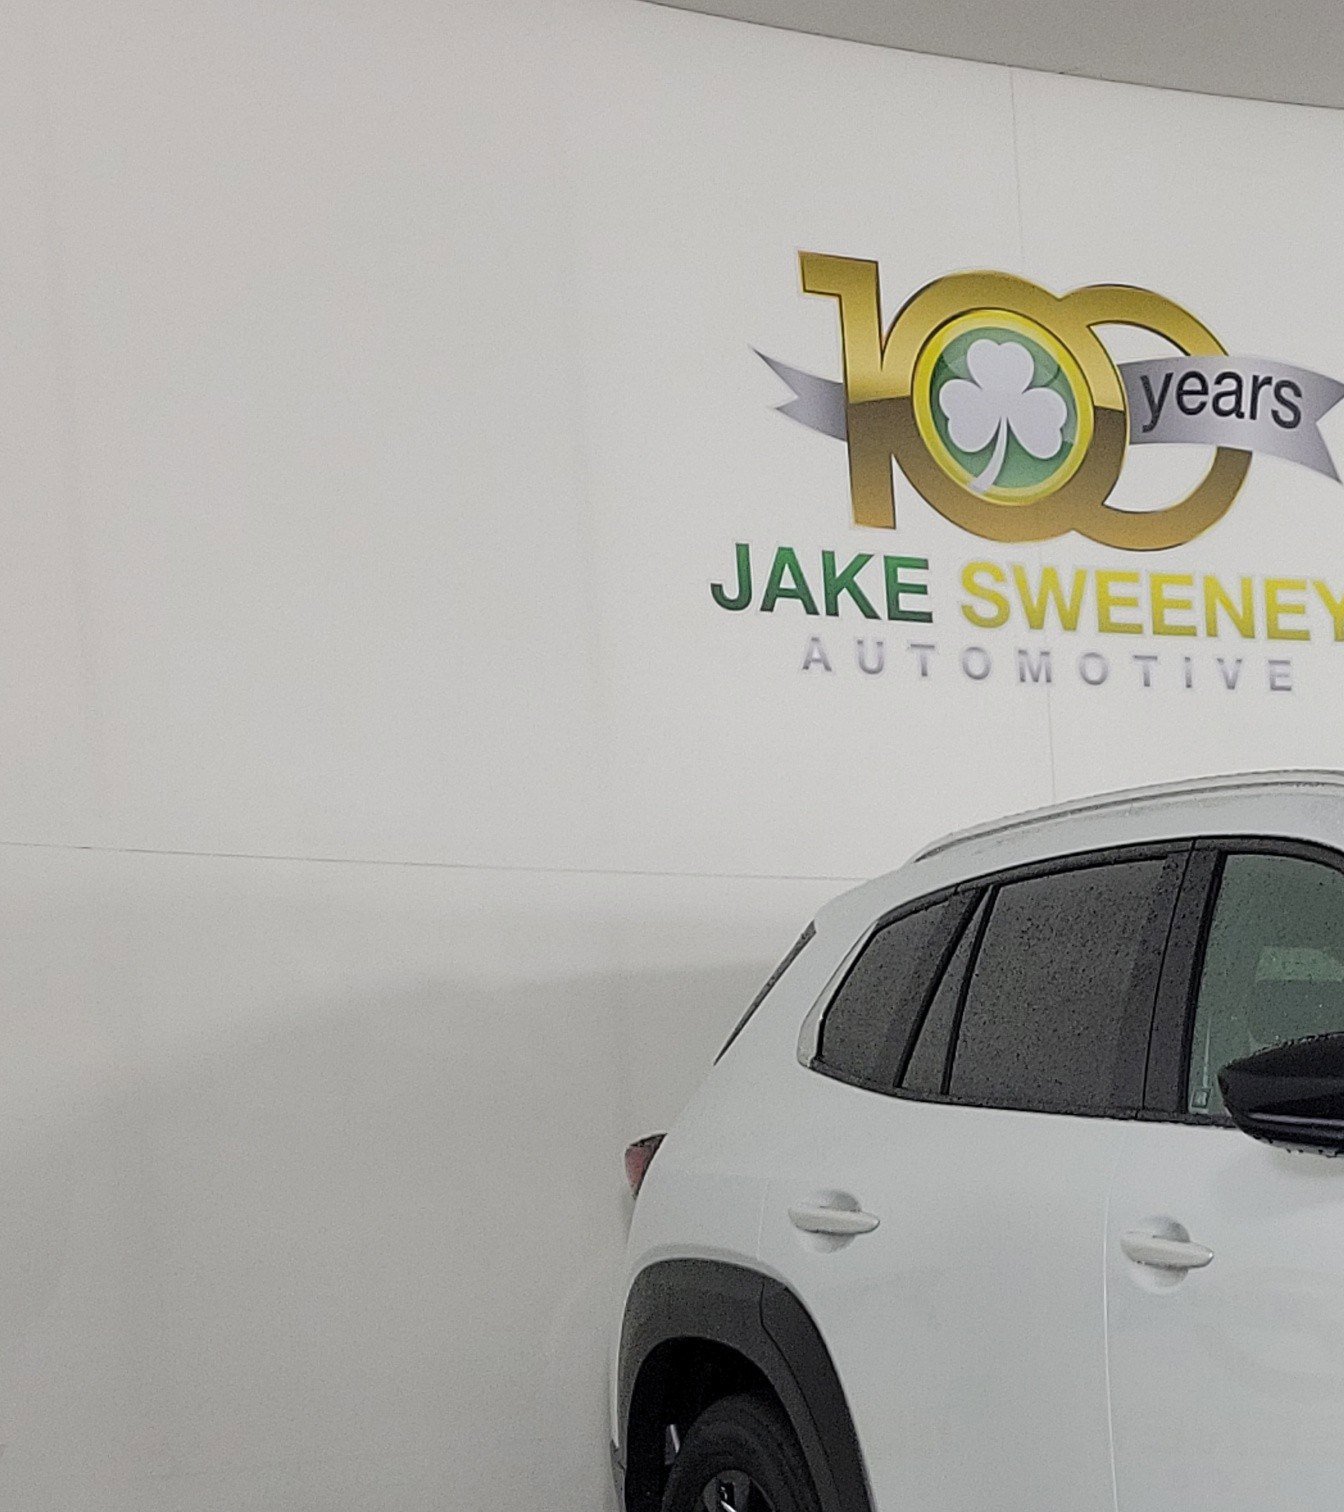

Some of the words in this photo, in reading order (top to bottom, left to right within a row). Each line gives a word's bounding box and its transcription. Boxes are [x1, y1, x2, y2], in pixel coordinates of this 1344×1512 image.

[797, 250, 1253, 552] 100
[1139, 370, 1304, 433] years
[710, 543, 934, 624] JAKE
[802, 637, 1294, 691] AUTOMOTIVE
